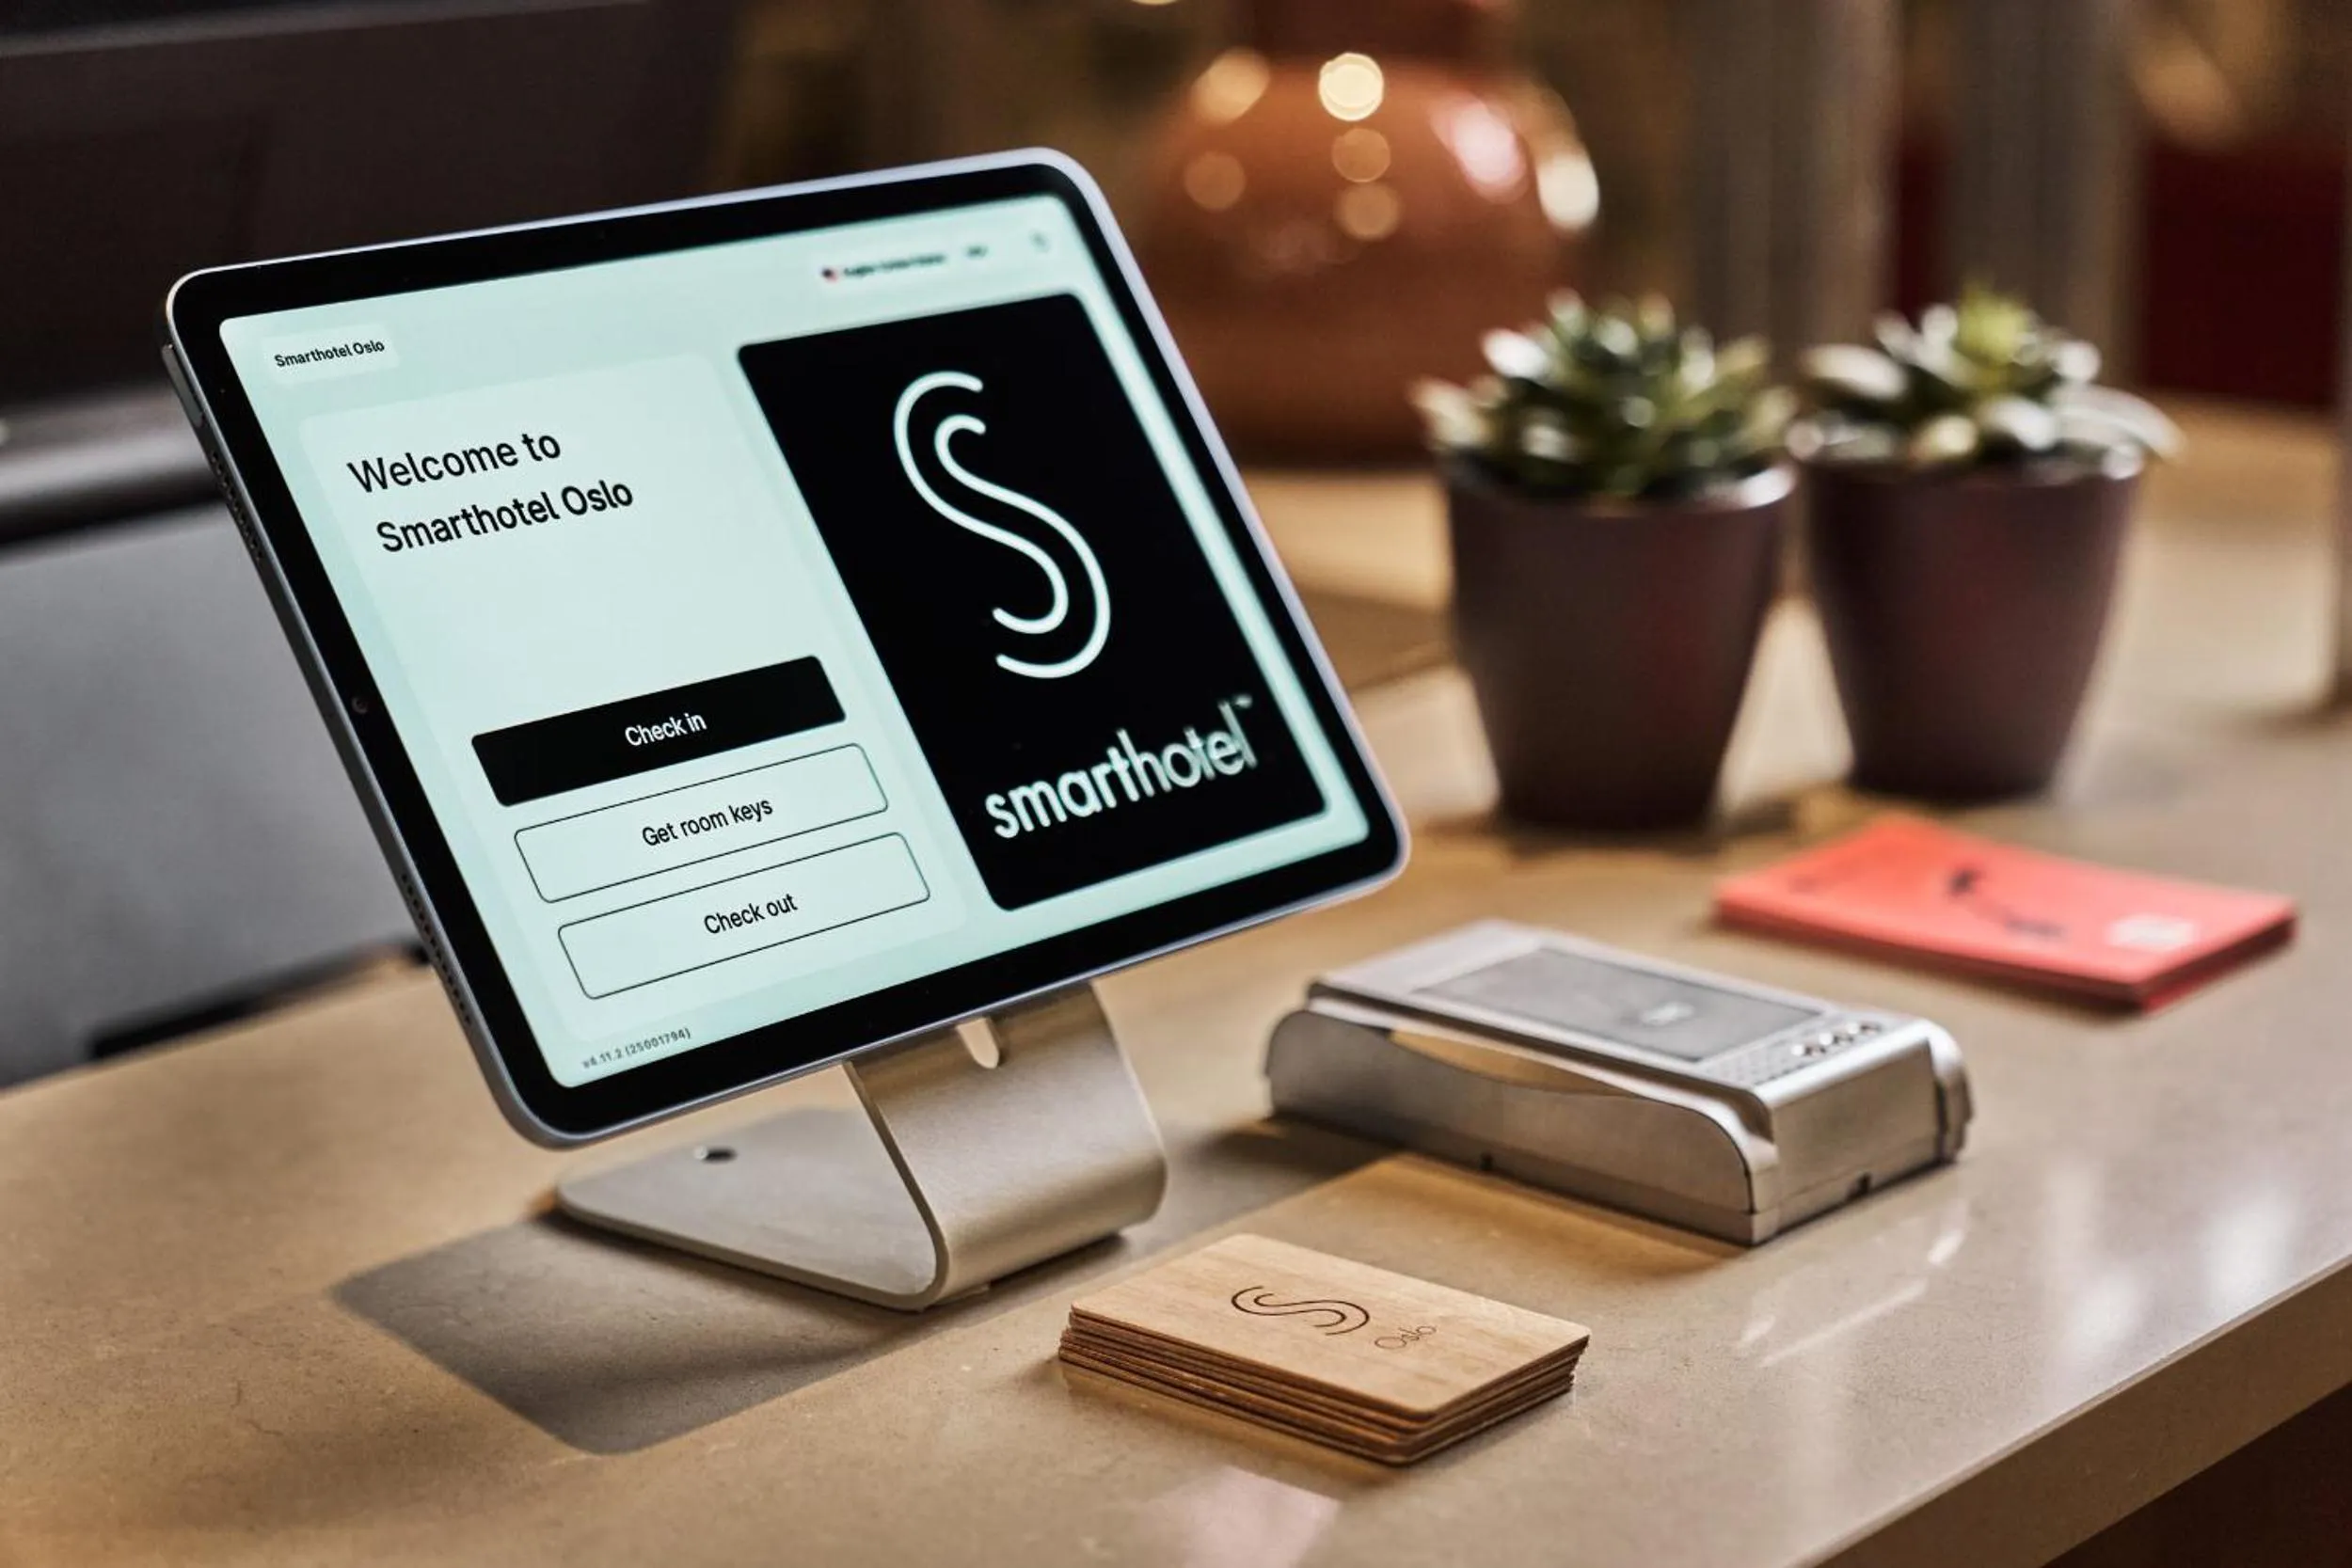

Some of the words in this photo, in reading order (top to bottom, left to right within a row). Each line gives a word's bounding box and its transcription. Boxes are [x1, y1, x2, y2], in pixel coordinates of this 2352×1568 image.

[274, 344, 352, 368] Smarthotel
[352, 339, 386, 356] Oslo
[347, 442, 519, 493] Welcome
[521, 432, 562, 463] to
[376, 491, 561, 553] Smarthotel
[560, 479, 634, 516] Oslo
[625, 717, 688, 748] Check
[688, 711, 707, 732] in
[985, 700, 1259, 838] smarthotel
[642, 822, 679, 847] Get
[679, 811, 730, 837] room
[729, 798, 774, 826] keys
[703, 902, 766, 935] Check
[766, 893, 799, 918] out
[1375, 1325, 1438, 1350] Oslo
